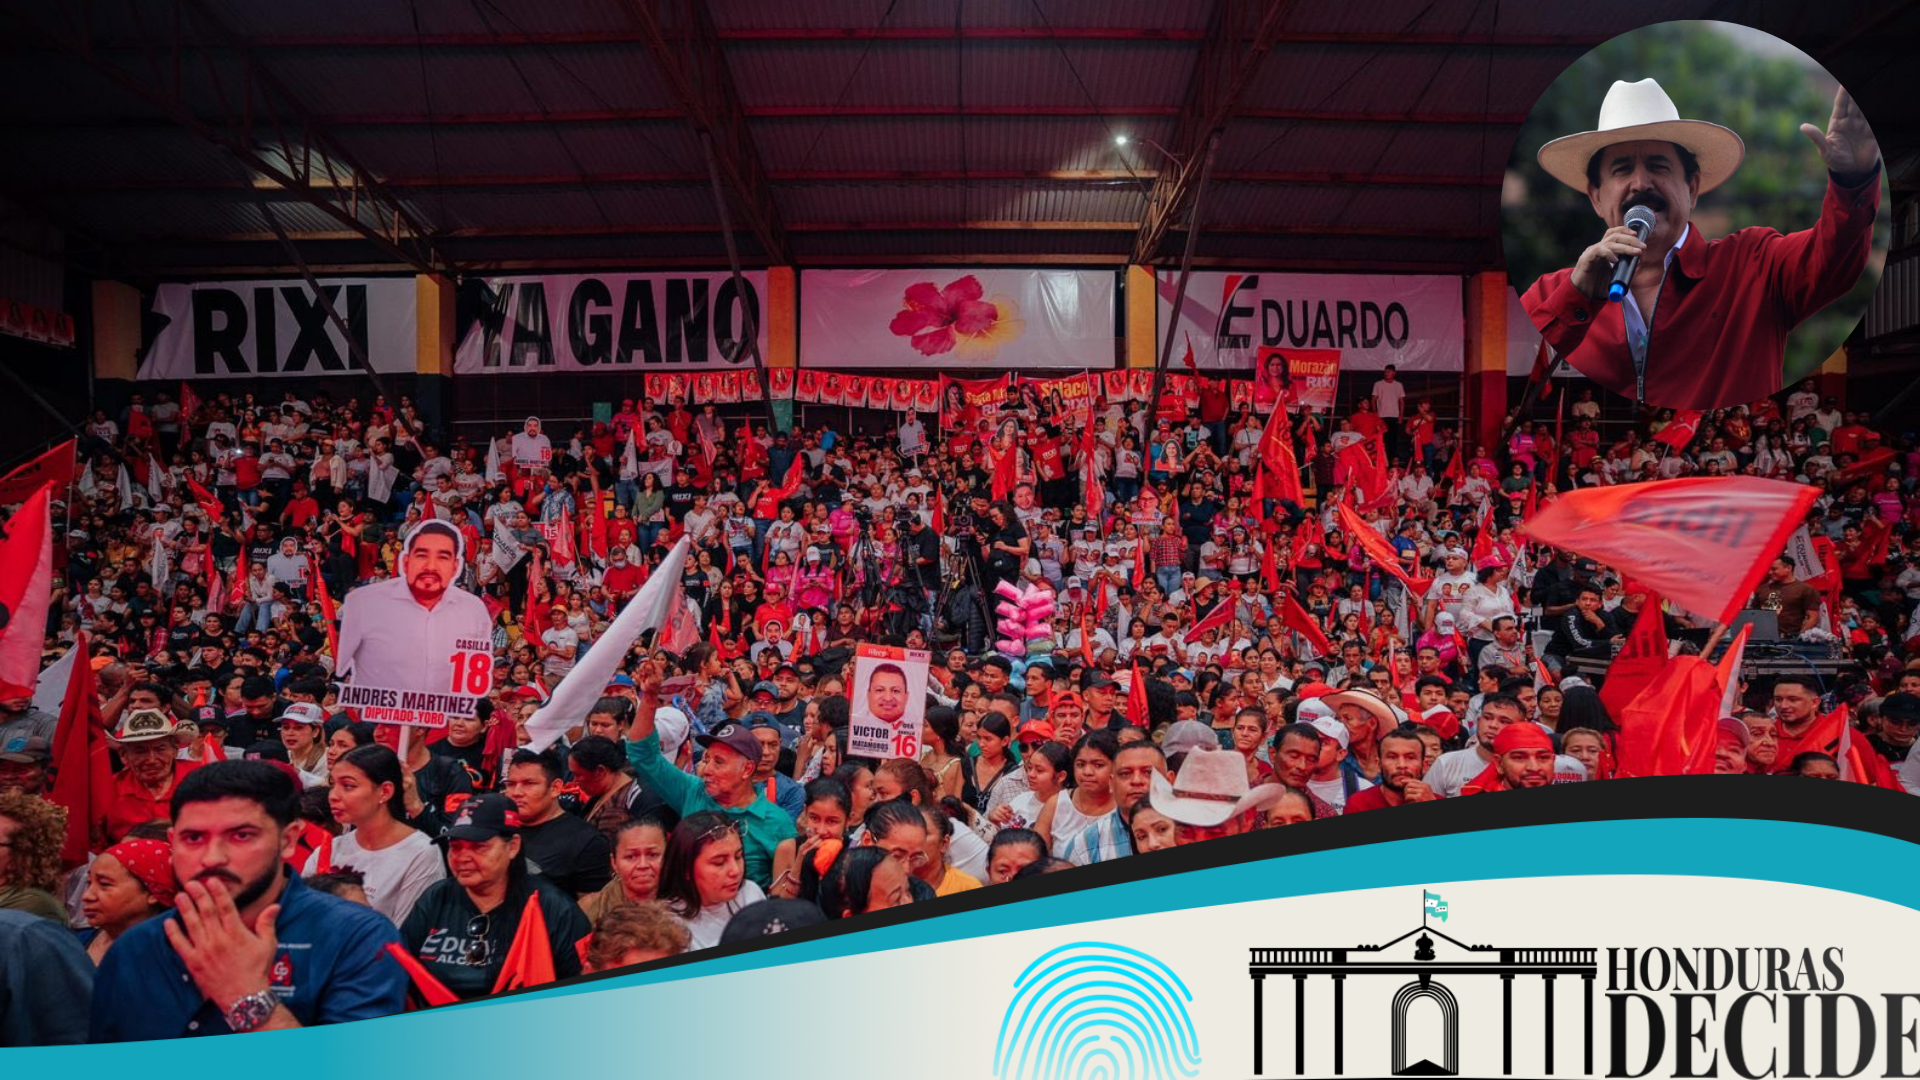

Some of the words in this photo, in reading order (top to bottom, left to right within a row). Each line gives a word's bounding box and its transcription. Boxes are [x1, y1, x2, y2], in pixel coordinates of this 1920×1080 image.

[567, 276, 761, 367] GANO
[1214, 275, 1410, 351] EDUARDO
[191, 284, 369, 375] RIXI
[456, 639, 490, 651] CASILLA
[450, 651, 491, 695] 18
[341, 687, 397, 708] ANDRES
[402, 692, 475, 715] MARTINEZ
[364, 706, 445, 725] DIPUTADO-YORO
[853, 725, 889, 739] VICTOR
[891, 735, 916, 757] 16
